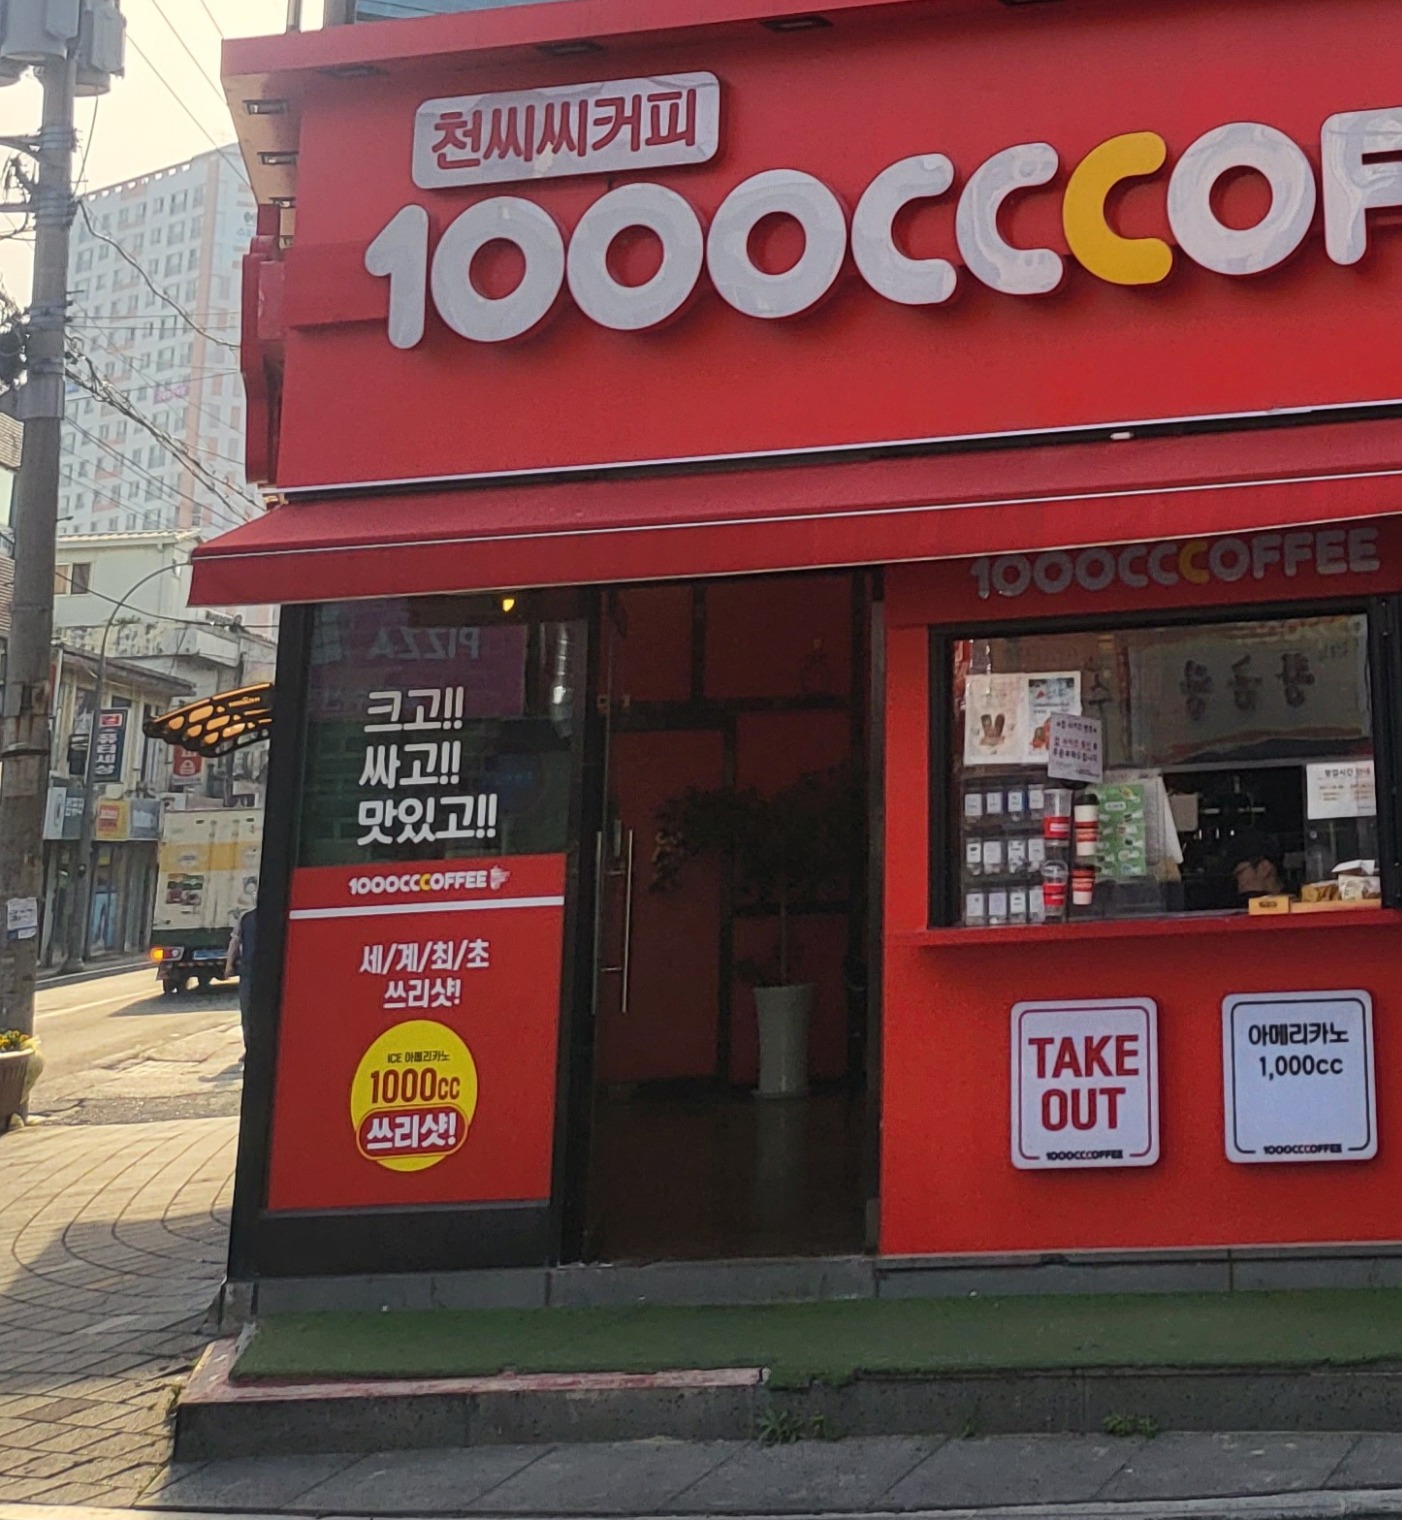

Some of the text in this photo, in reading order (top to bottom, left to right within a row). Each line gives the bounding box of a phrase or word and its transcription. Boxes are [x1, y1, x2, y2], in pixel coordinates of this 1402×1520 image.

[431, 87, 698, 169] 천씨씨커피
[969, 527, 1381, 599] 1000CCCOFFEE
[364, 686, 464, 732] 크고!!
[359, 740, 461, 789] 싸고!!
[356, 793, 498, 846] 맛있고!!
[348, 870, 487, 896] 1000CCCOFFEE
[360, 938, 490, 975] 세/계/최/초
[383, 977, 461, 1008] 쓰리샷!
[1248, 1021, 1349, 1047] 아메리카노
[387, 1051, 402, 1064] ICE
[1028, 1034, 1139, 1079] TAKE
[1259, 1053, 1343, 1081] 1,000cc
[370, 1067, 460, 1104] 1000cc
[1041, 1087, 1126, 1132] OUT
[366, 1112, 456, 1150] 쓰리샷!
